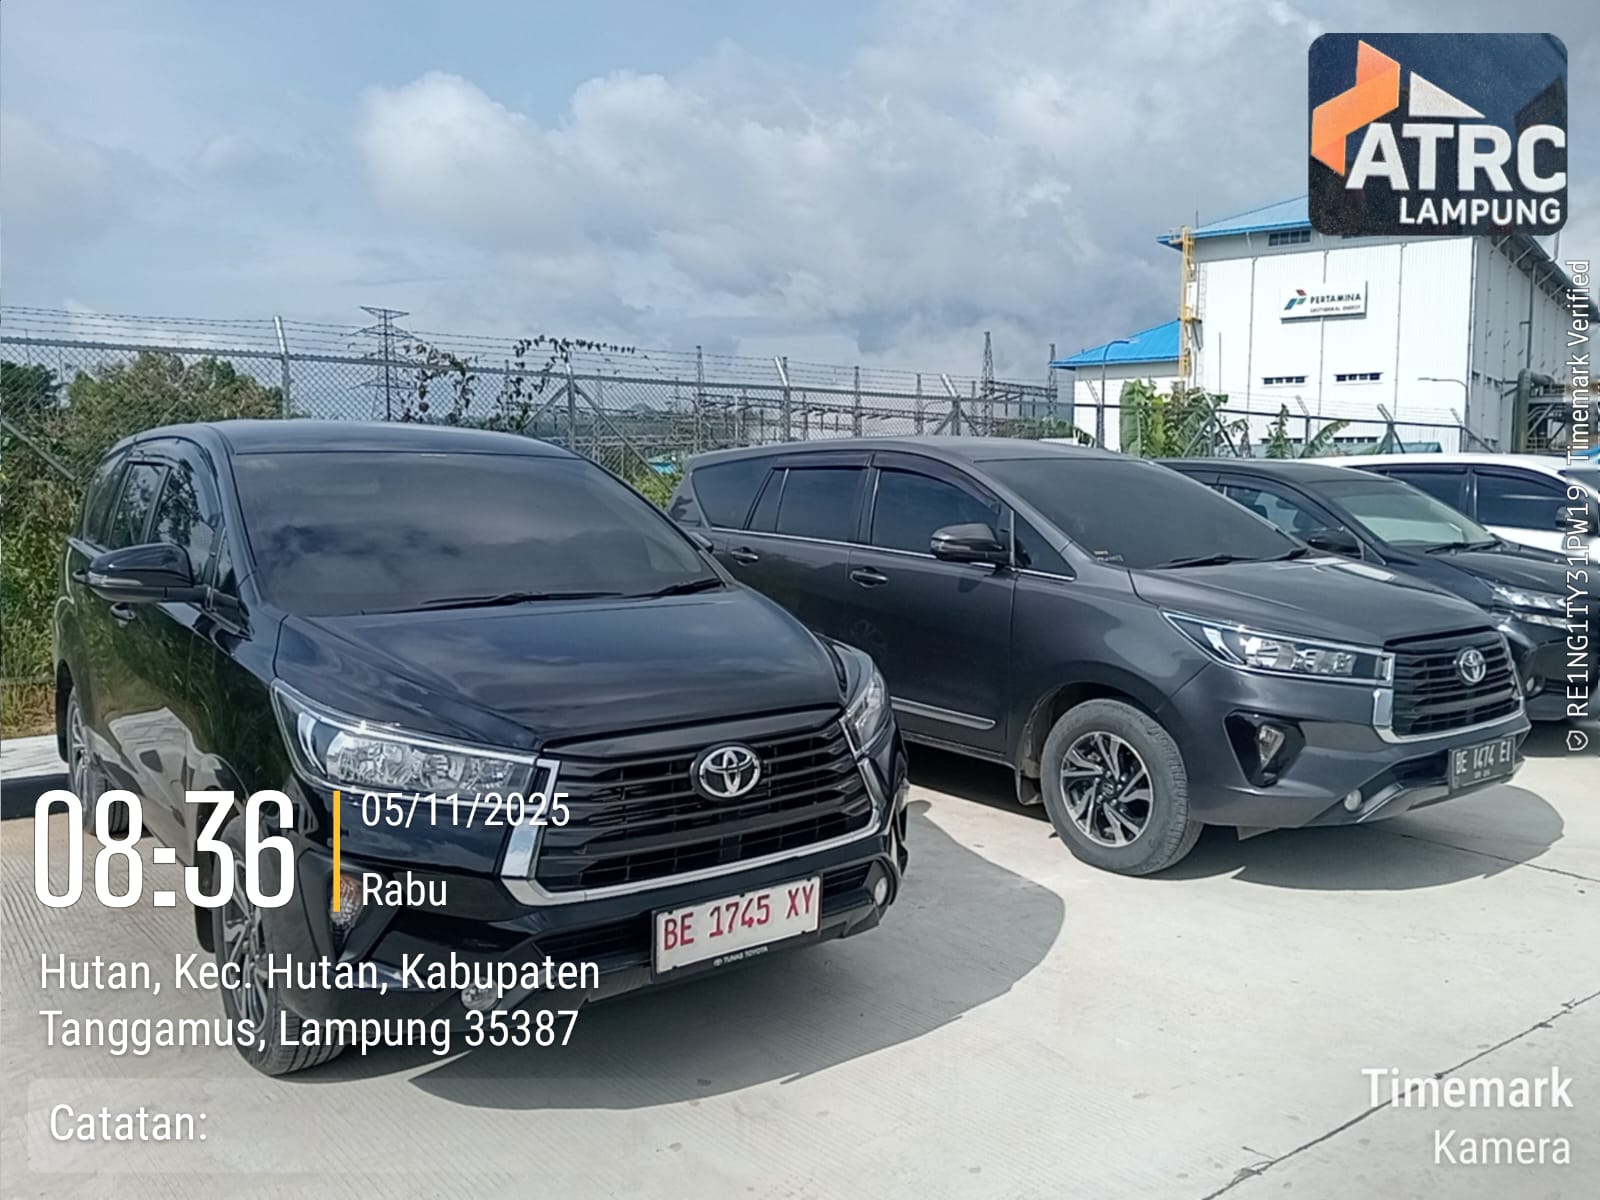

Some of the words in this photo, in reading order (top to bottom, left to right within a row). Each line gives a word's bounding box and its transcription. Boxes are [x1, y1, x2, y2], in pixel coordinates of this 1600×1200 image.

[1310, 293, 1361, 303] PERTAMINA
[1456, 750, 1468, 774] BE
[664, 911, 695, 951] BE
[709, 894, 771, 937] 1745
[786, 883, 815, 919] XY
